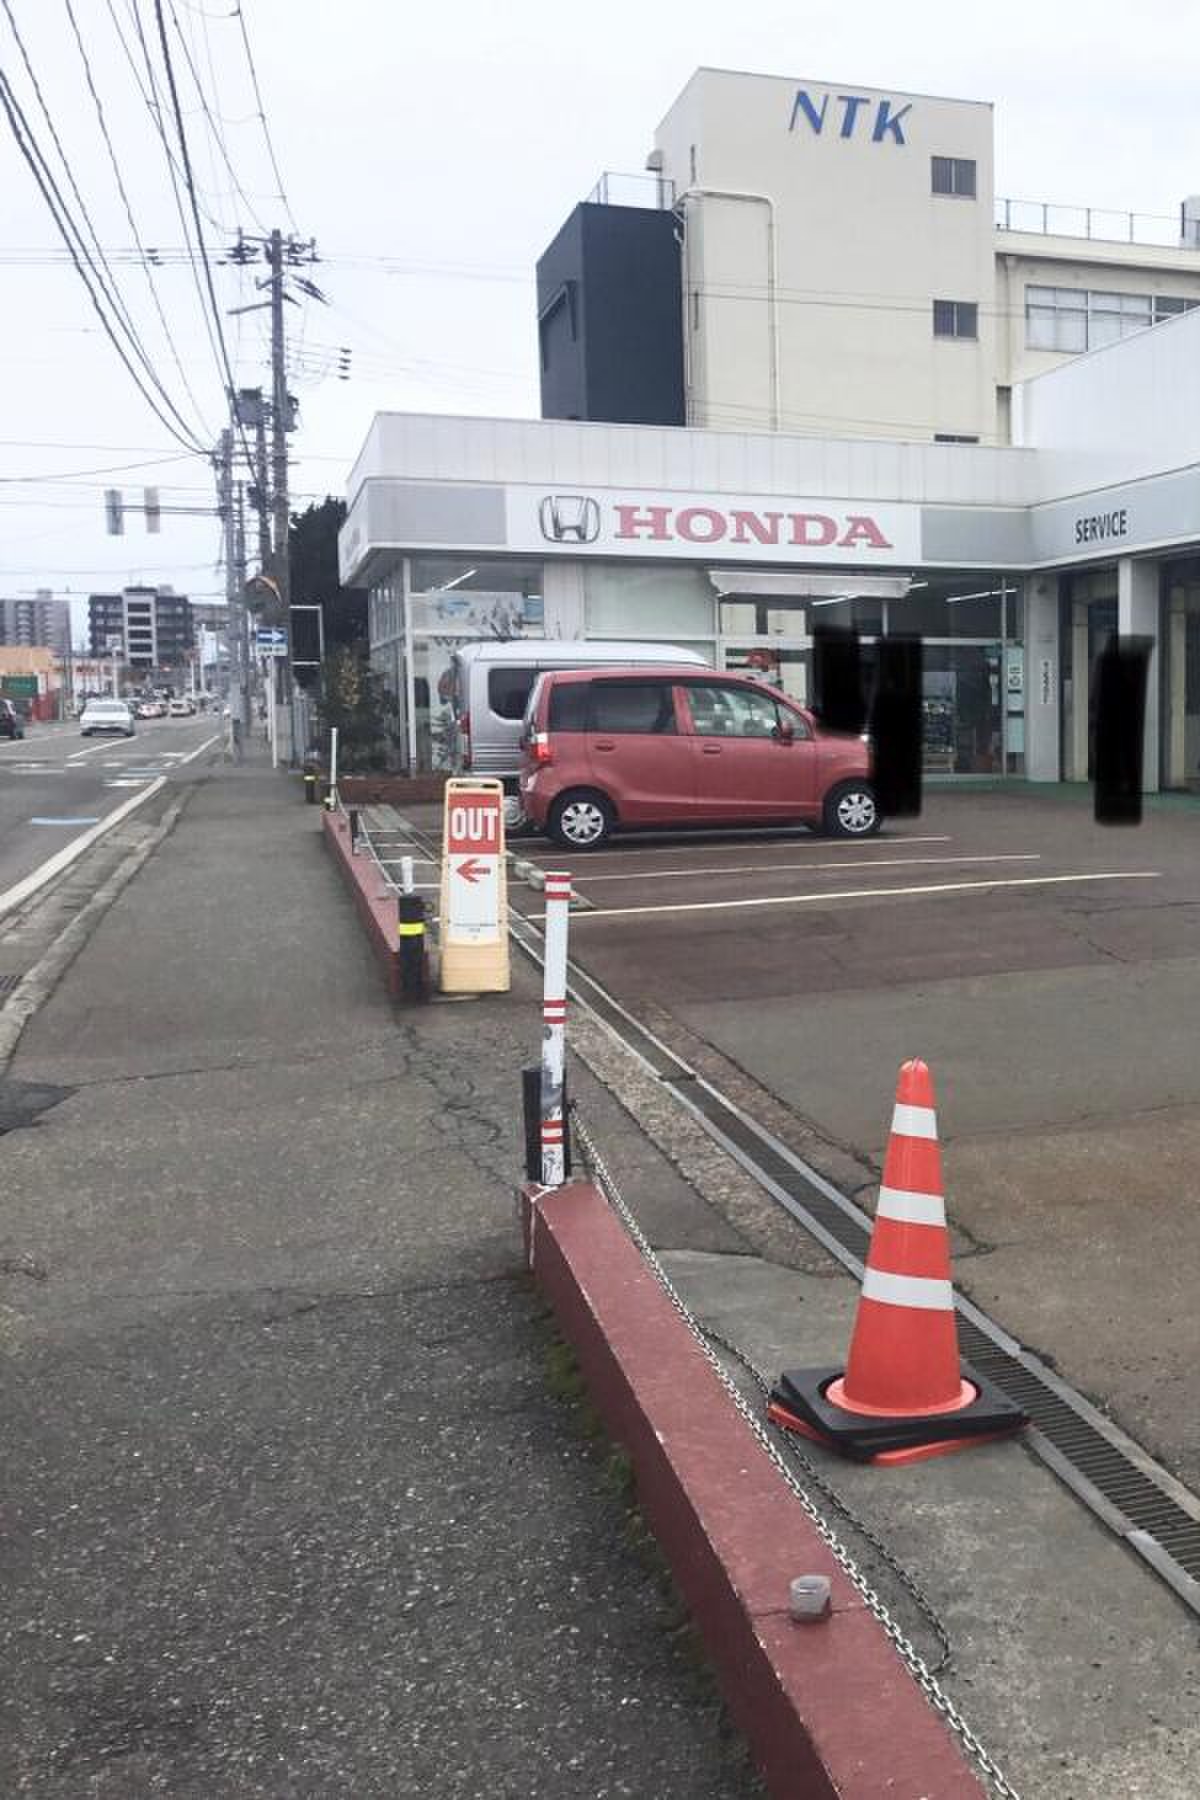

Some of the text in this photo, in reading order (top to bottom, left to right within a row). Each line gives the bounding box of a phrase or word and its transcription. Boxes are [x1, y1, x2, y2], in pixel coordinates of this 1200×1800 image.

[788, 90, 912, 144] NTK
[613, 506, 893, 549] HONDA
[1075, 510, 1128, 544] SERVICE
[451, 807, 499, 841] OUT
